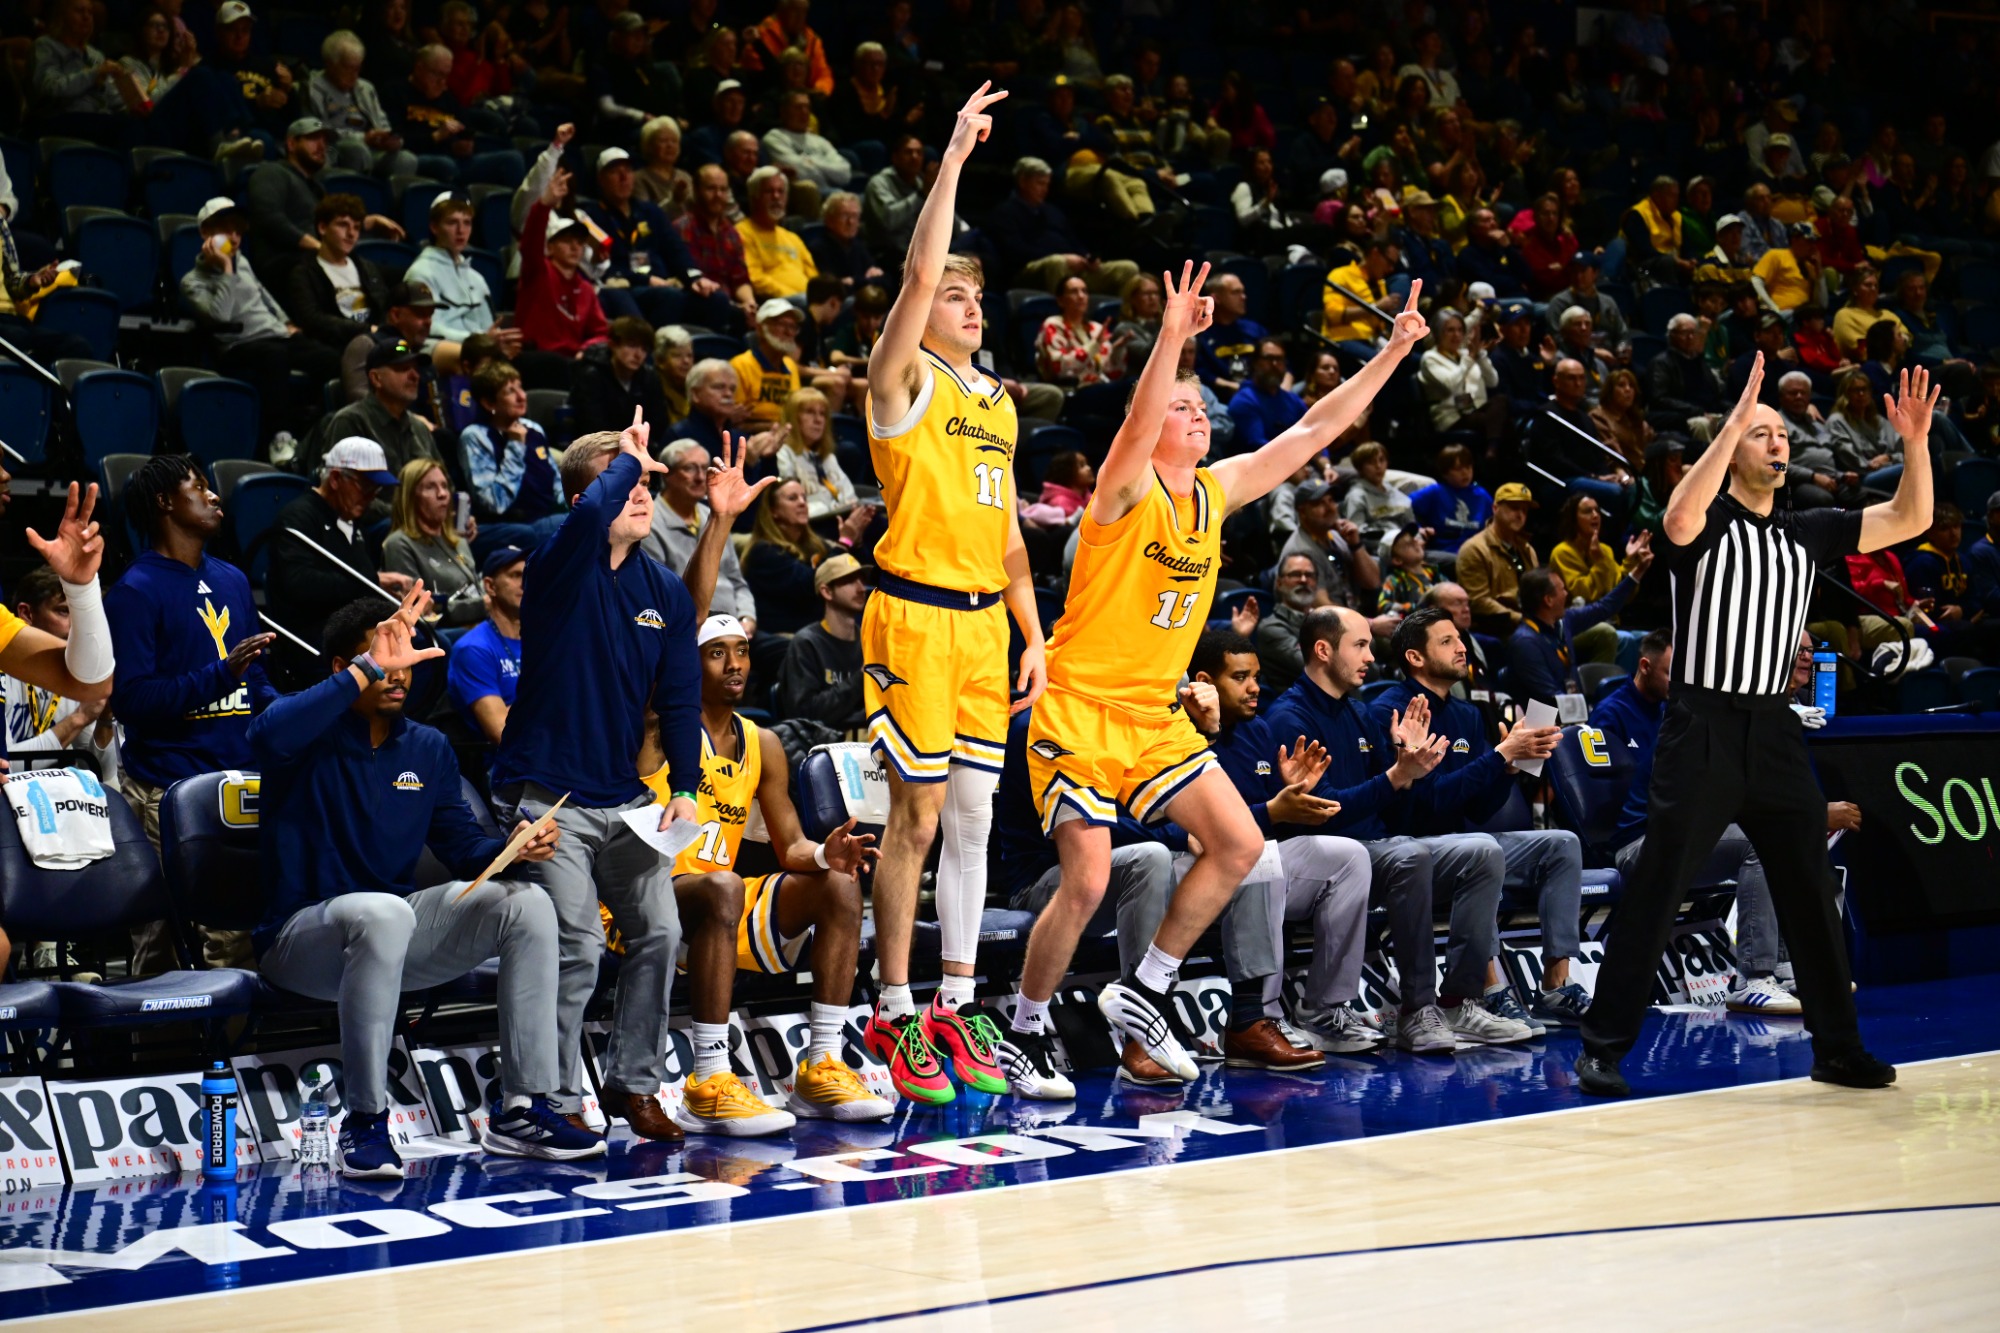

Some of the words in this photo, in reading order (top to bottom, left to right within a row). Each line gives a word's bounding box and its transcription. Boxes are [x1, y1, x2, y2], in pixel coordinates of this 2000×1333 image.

[973, 462, 1004, 510] 11
[1150, 589, 1200, 630] 13
[1577, 728, 1612, 767] C
[218, 775, 261, 829] C
[141, 996, 211, 1013] CHATTANOOGA
[1707, 990, 1727, 1004] NOR
[210, 1095, 224, 1165] POWERADE
[0, 1157, 57, 1170] ROUP
[107, 1151, 183, 1168] WEALTH
[0, 1110, 1267, 1292] MOCS.COM
